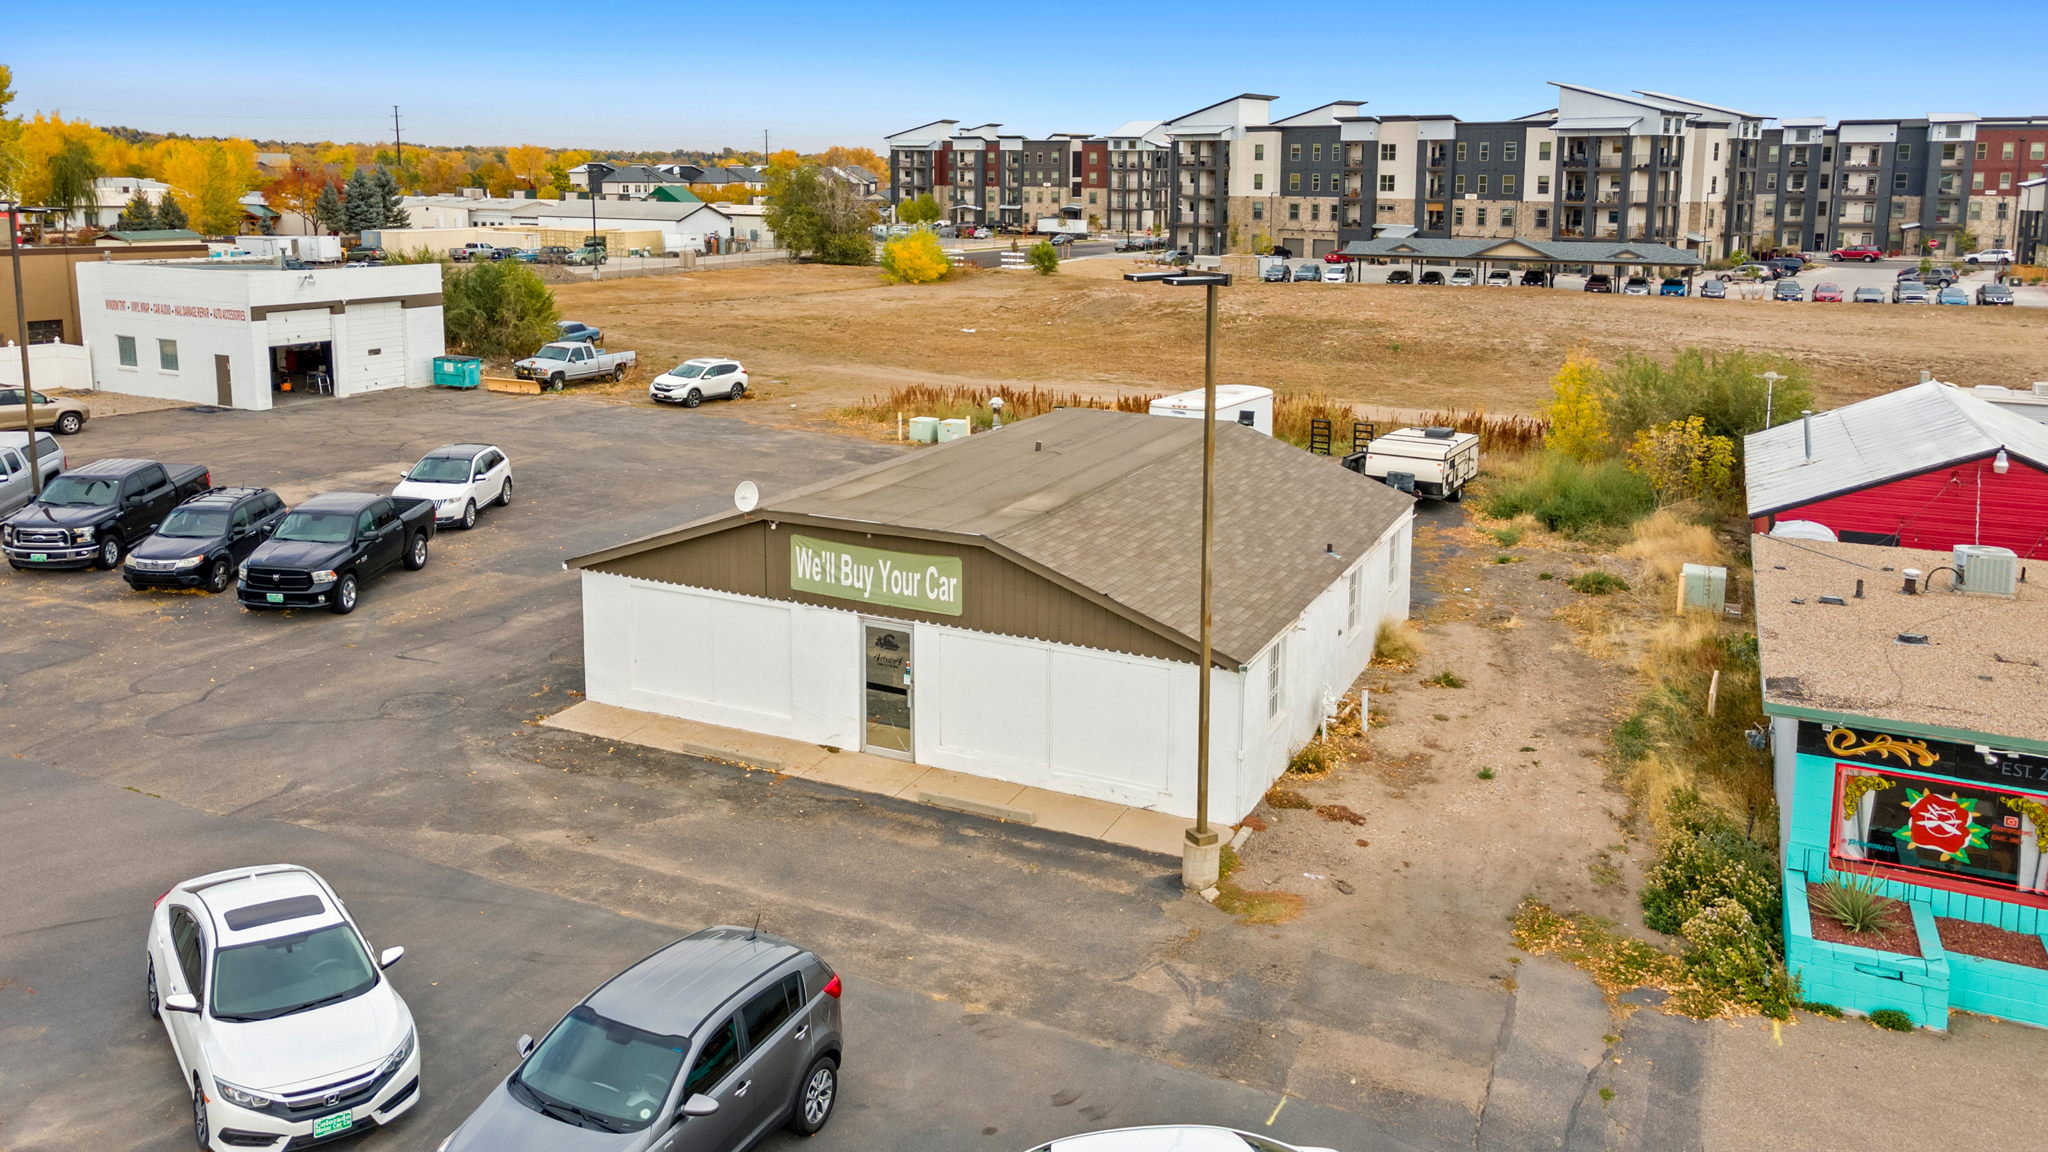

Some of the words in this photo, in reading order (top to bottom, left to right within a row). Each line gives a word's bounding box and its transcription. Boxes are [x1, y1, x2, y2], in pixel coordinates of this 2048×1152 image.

[796, 546, 835, 584] We'll
[840, 554, 874, 598] Buy
[878, 559, 921, 597] Your
[925, 566, 957, 602] Car
[2001, 762, 2033, 778] EST.
[315, 1113, 352, 1129] Colorado
[316, 1125, 332, 1133] Motor
[333, 1121, 343, 1129] Car
